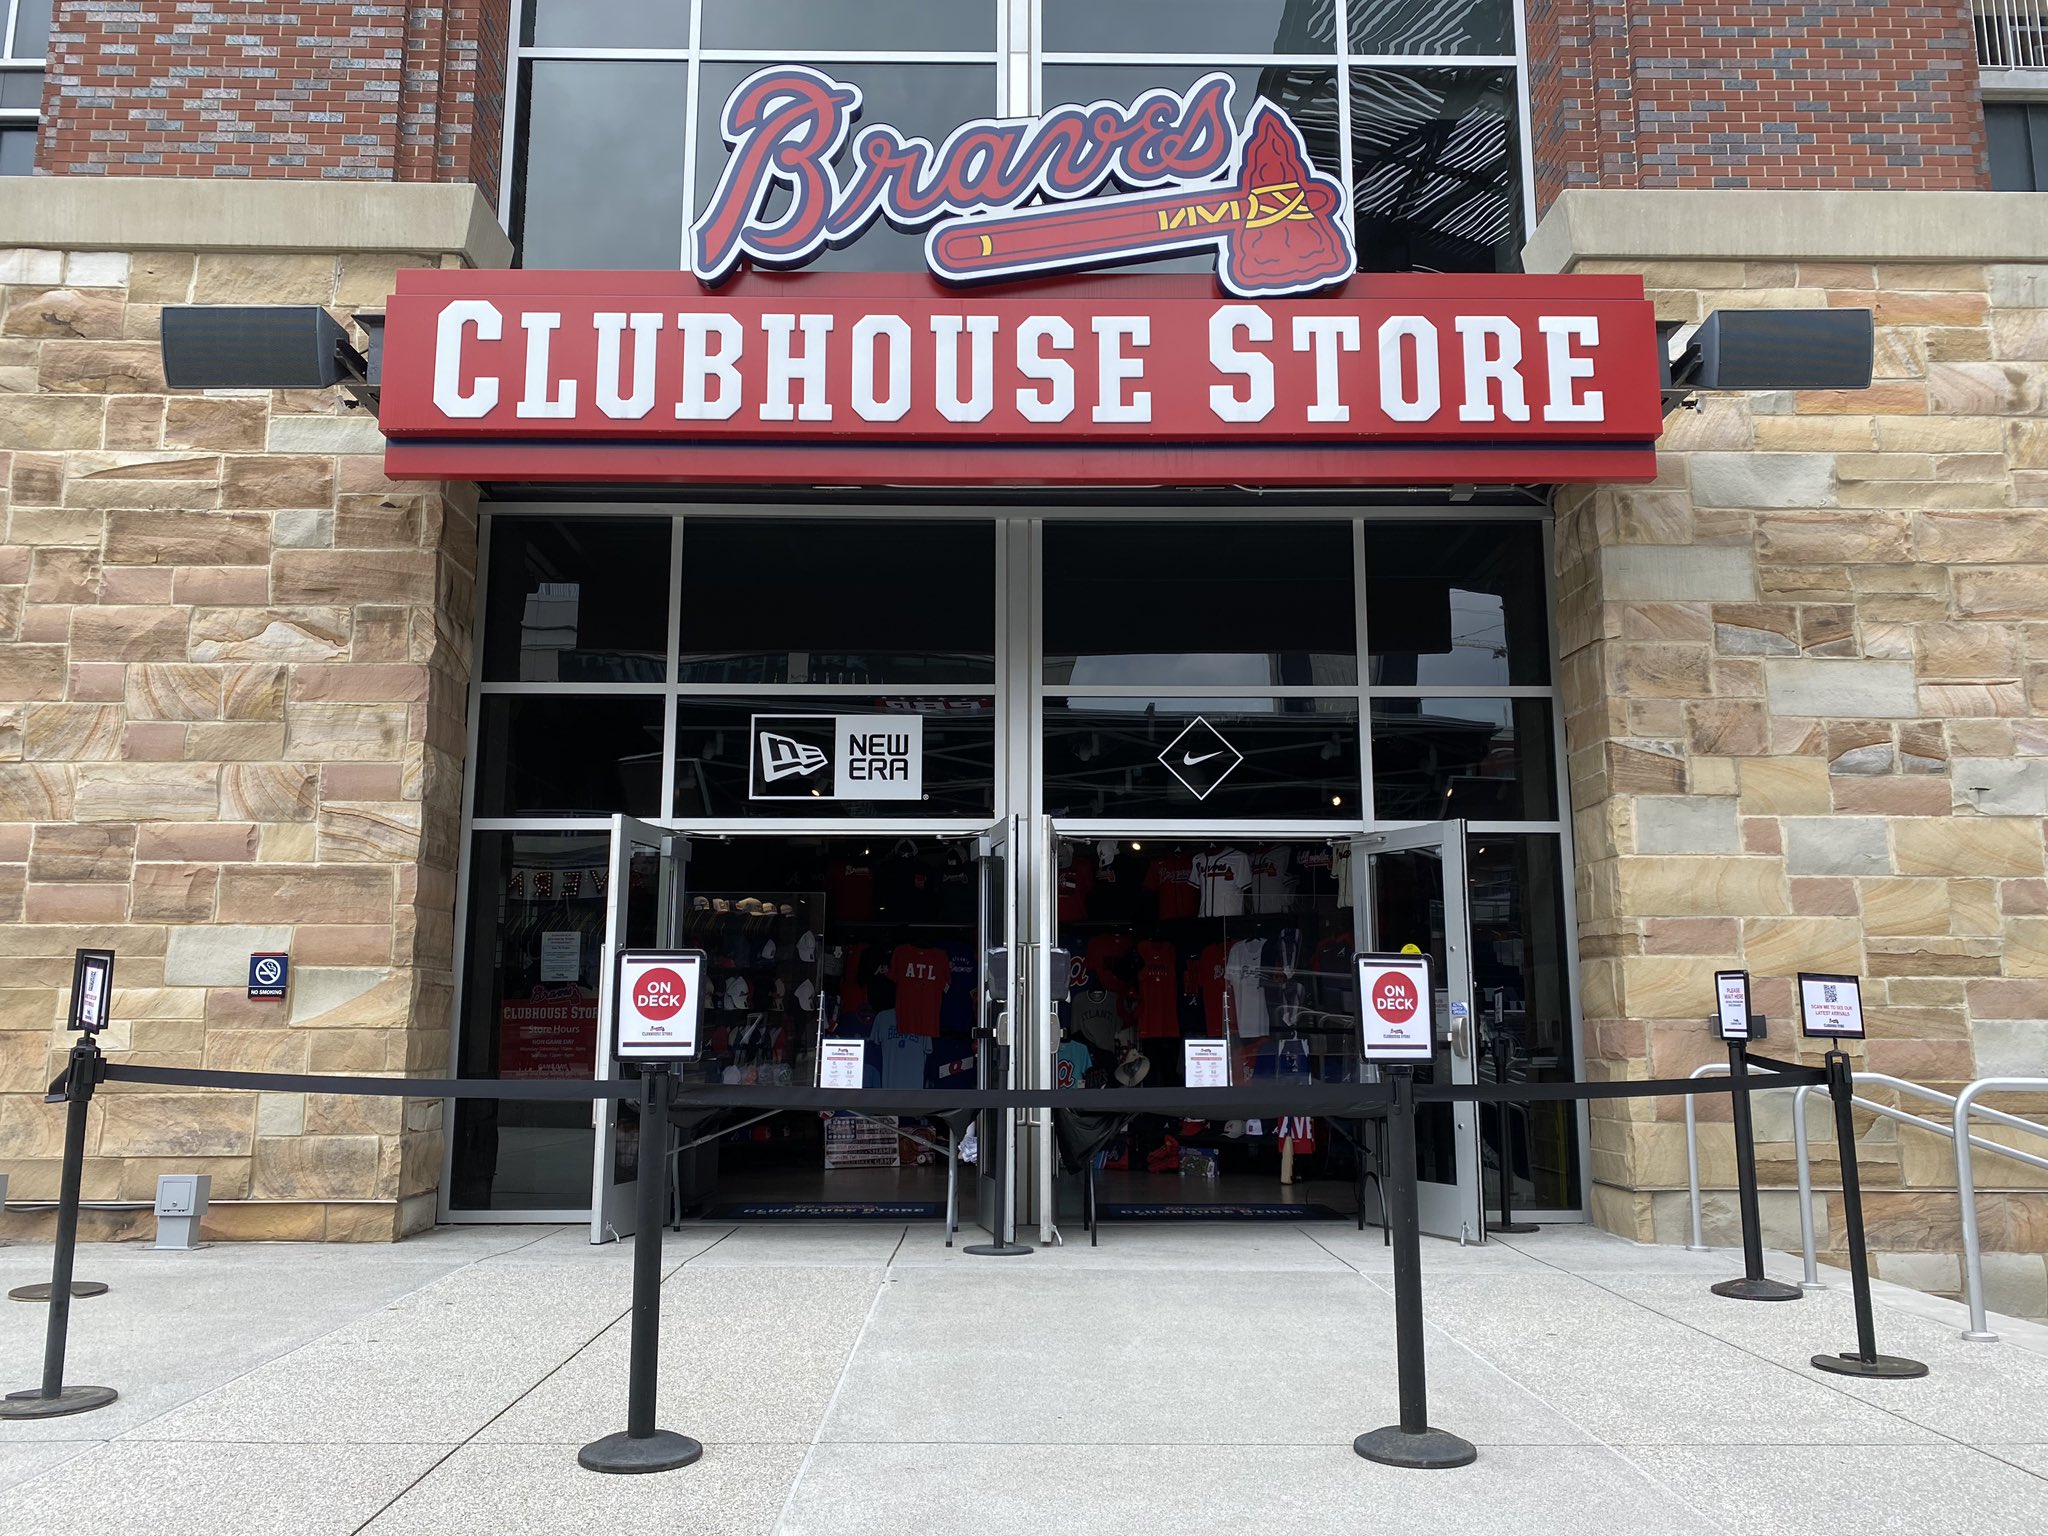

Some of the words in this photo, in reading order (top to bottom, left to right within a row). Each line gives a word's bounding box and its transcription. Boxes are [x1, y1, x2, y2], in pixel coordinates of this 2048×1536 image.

[690, 64, 1237, 283] Braves
[432, 299, 1152, 423] CLUBHOUSE
[1208, 304, 1605, 423] STORE
[849, 734, 909, 756] NEW
[849, 758, 909, 780] ERA
[905, 962, 936, 980] ATL
[647, 981, 671, 994] ON
[1384, 985, 1405, 997] ON
[637, 994, 681, 1007] DECK
[1376, 998, 1414, 1010] DECK
[503, 1006, 567, 1020] CLUBHOUSE
[528, 1024, 552, 1034] Store
[553, 1024, 580, 1034] Hours
